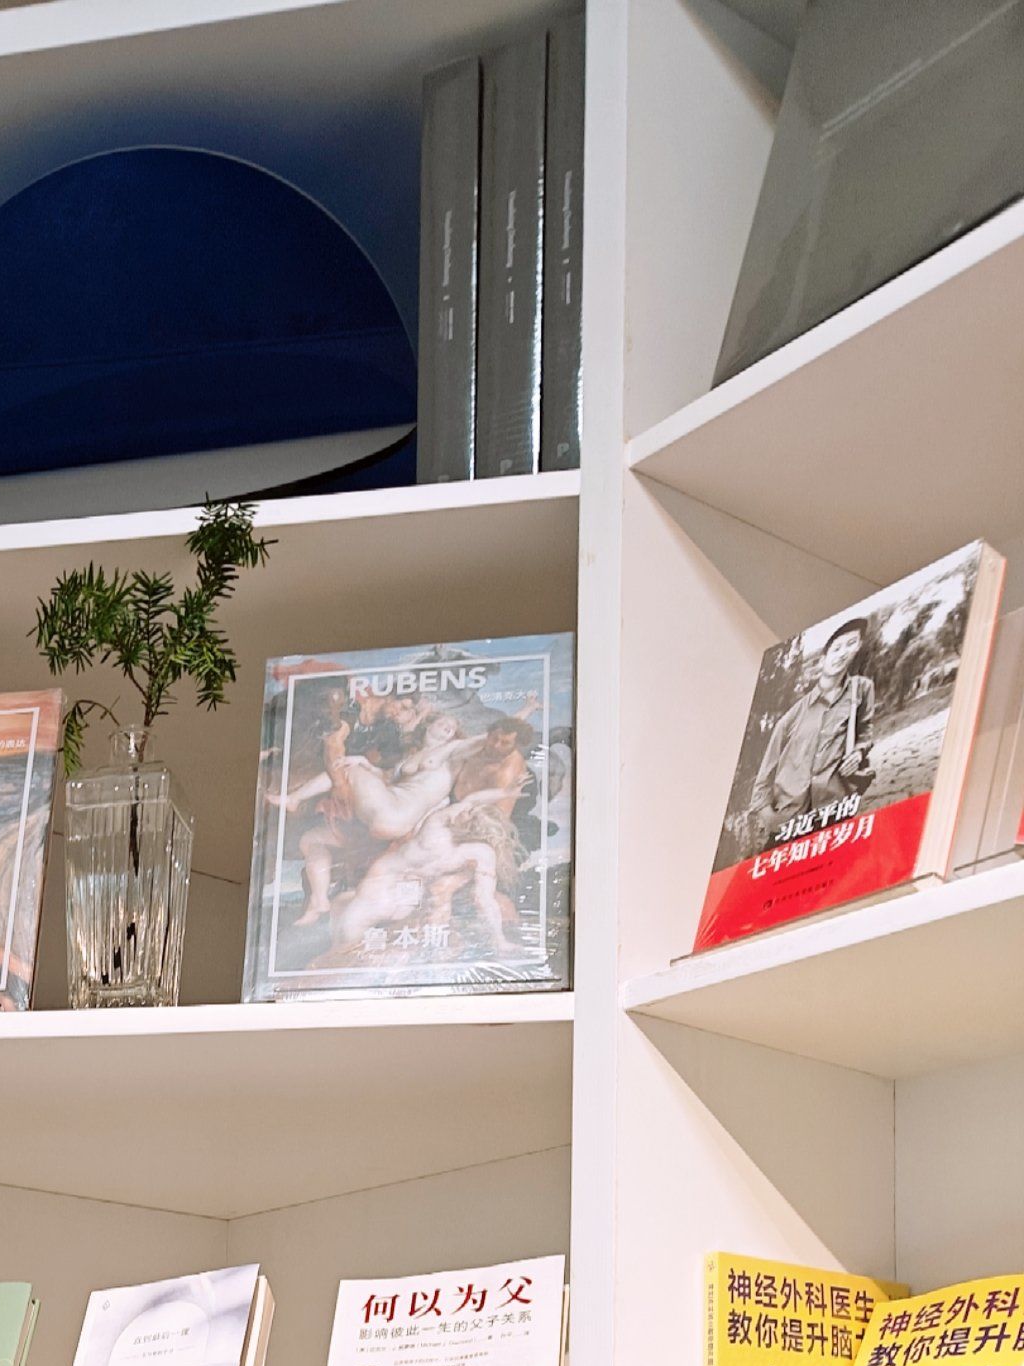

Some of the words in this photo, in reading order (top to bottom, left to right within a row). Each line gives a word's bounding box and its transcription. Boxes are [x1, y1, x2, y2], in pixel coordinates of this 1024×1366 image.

[348, 666, 487, 700] RUBENS
[774, 793, 862, 842] 习近平的
[747, 814, 876, 880] 七年知青岁月
[361, 924, 451, 952] 鲁本斯
[361, 1275, 533, 1324] 何以为父
[727, 1268, 875, 1323] 神经外科医生
[358, 1310, 533, 1340] 影响彼此一生的父子关系
[727, 1309, 866, 1360] 教你提升脑
